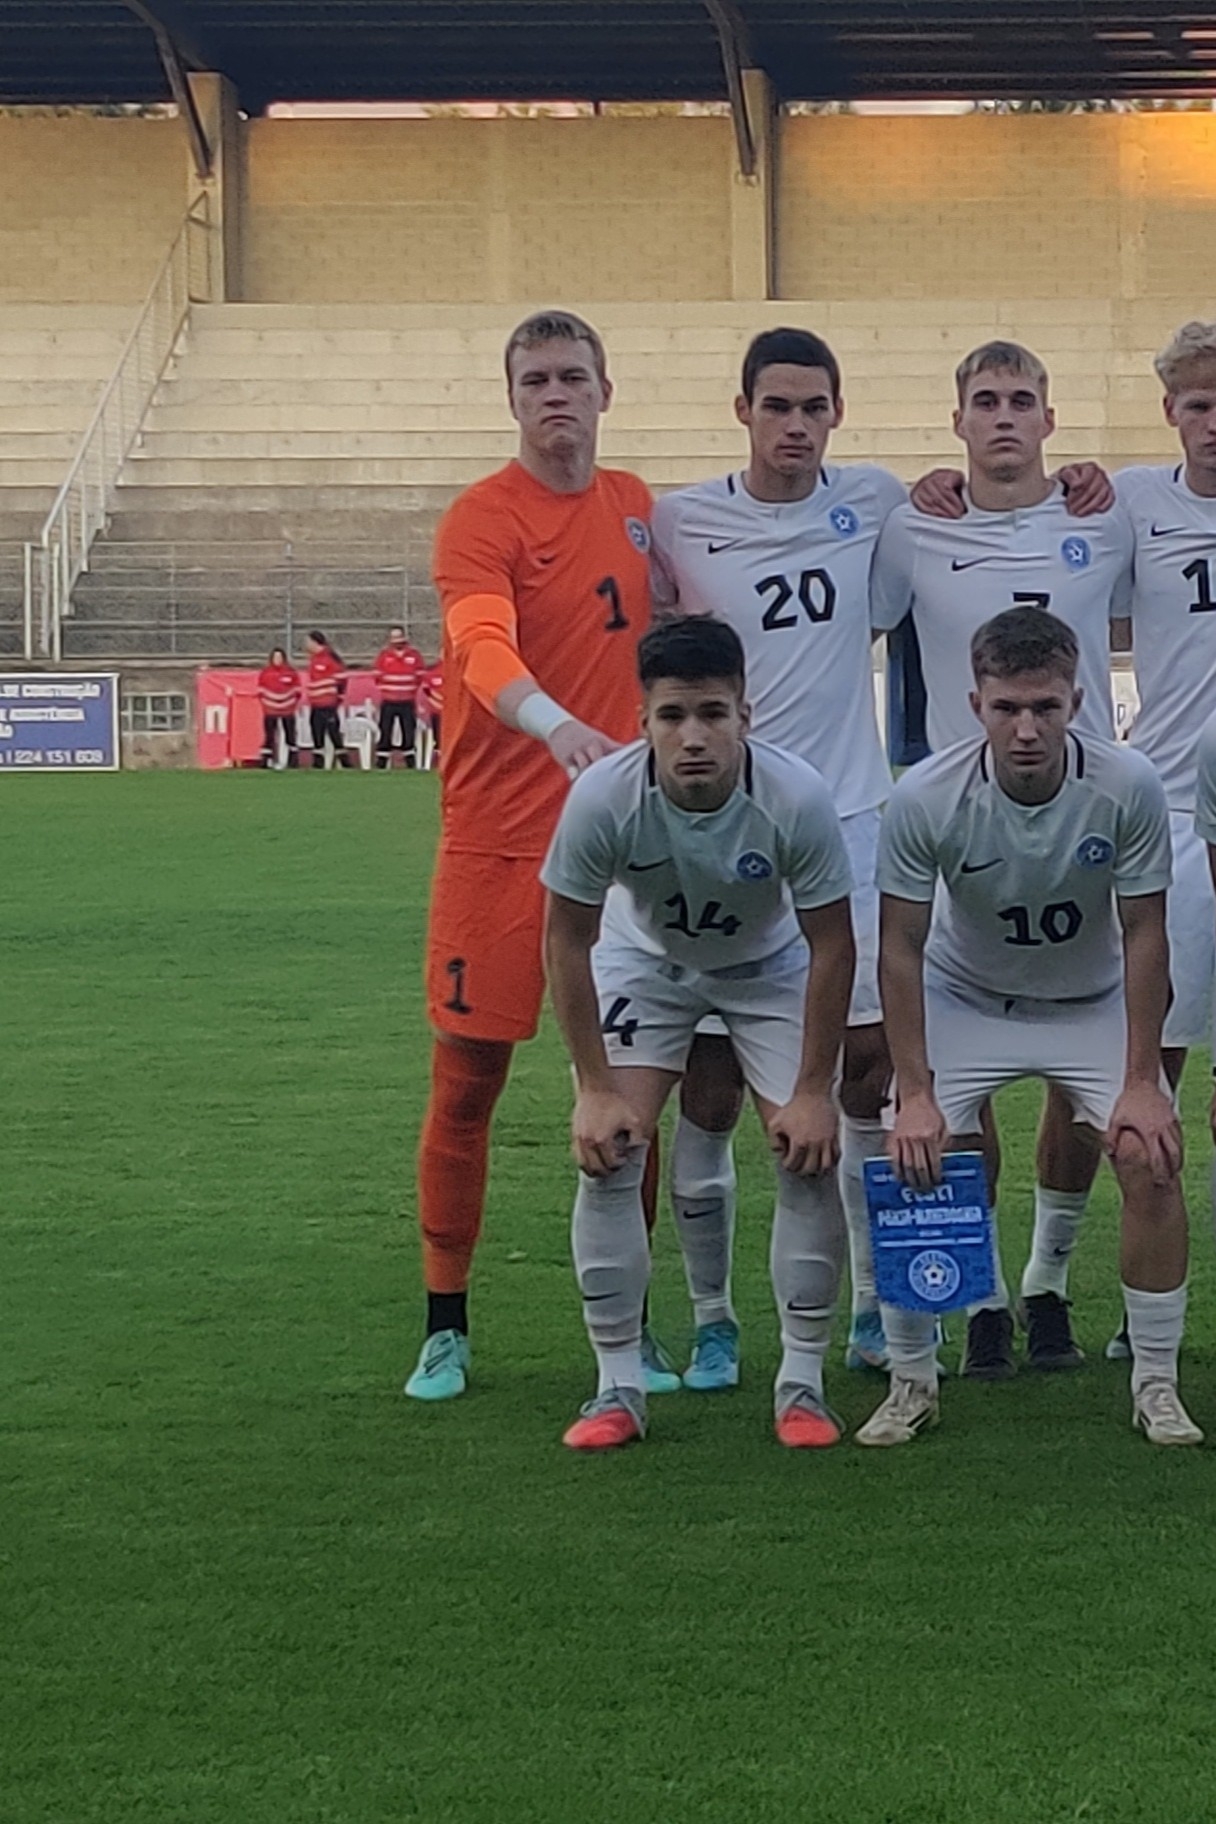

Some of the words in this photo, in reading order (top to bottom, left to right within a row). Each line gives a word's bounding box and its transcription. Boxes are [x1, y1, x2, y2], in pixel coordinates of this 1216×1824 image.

[596, 576, 630, 633] 1
[754, 568, 837, 632] 20
[663, 891, 741, 938] 14
[997, 900, 1083, 946] 10
[444, 957, 472, 1015] 1
[602, 996, 639, 1047] 4
